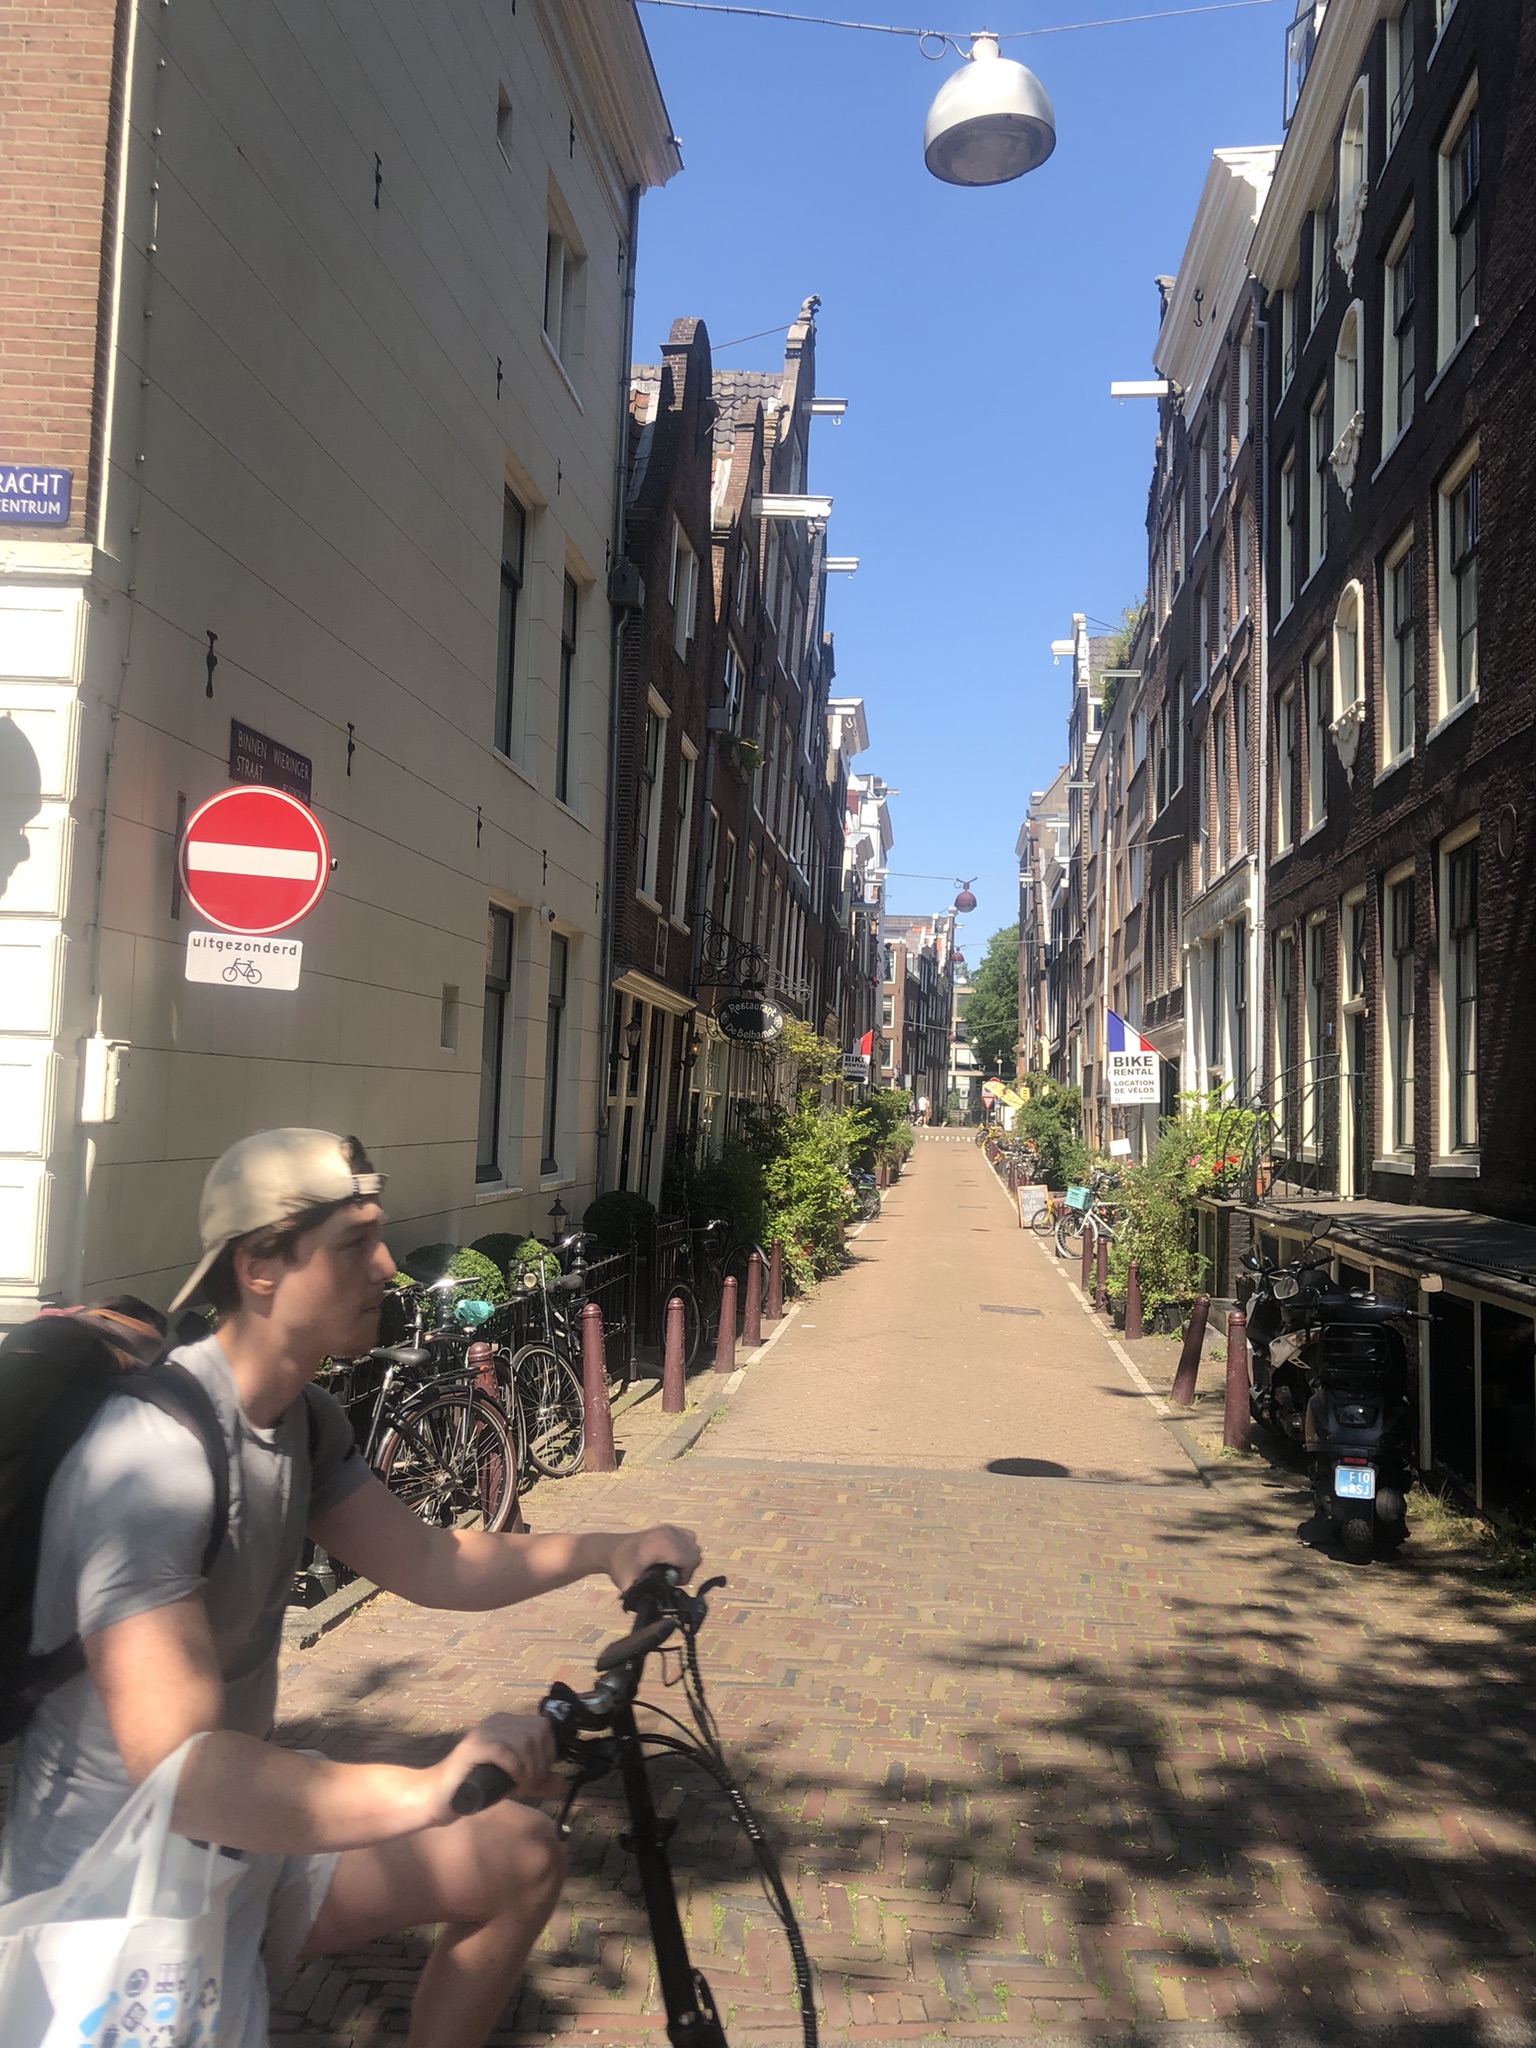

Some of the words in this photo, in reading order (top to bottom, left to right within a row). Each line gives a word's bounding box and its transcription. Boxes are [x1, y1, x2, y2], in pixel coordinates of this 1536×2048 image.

[0, 498, 61, 515] ENTRUM
[238, 729, 268, 760] BINNEN
[273, 748, 310, 781] WIERINGER
[236, 755, 264, 782] STRAAT
[193, 937, 297, 956] uitgezonderd
[728, 1001, 777, 1018] Restaurant
[725, 1023, 737, 1035] De
[736, 1025, 777, 1040] Belhamel
[845, 1055, 866, 1063] BIKE
[1114, 1056, 1153, 1067] BIKE
[1113, 1068, 1154, 1076] RENTAL
